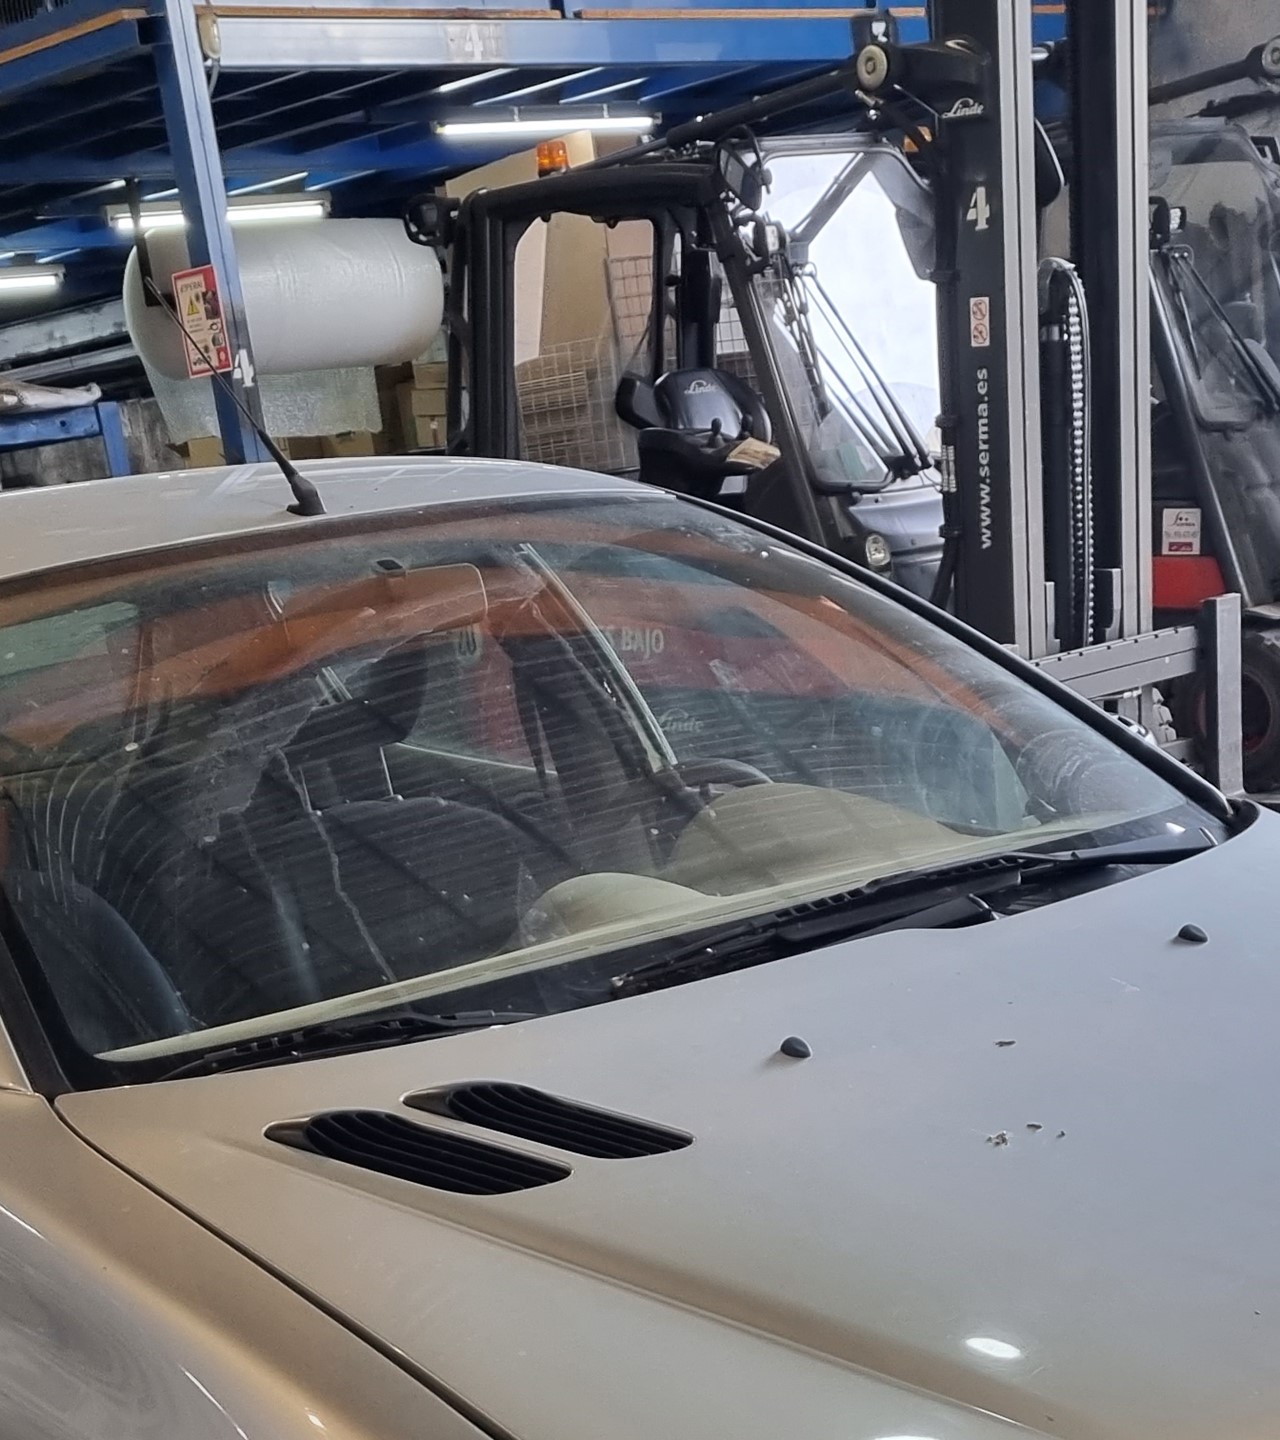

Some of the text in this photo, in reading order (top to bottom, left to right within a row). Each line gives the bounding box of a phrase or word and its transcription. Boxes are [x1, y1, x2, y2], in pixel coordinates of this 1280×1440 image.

[941, 97, 984, 119] Linde
[966, 186, 990, 231] 4
[232, 348, 255, 387] 4
[977, 368, 992, 549] www.serma.es
[621, 626, 665, 659] BAJO
